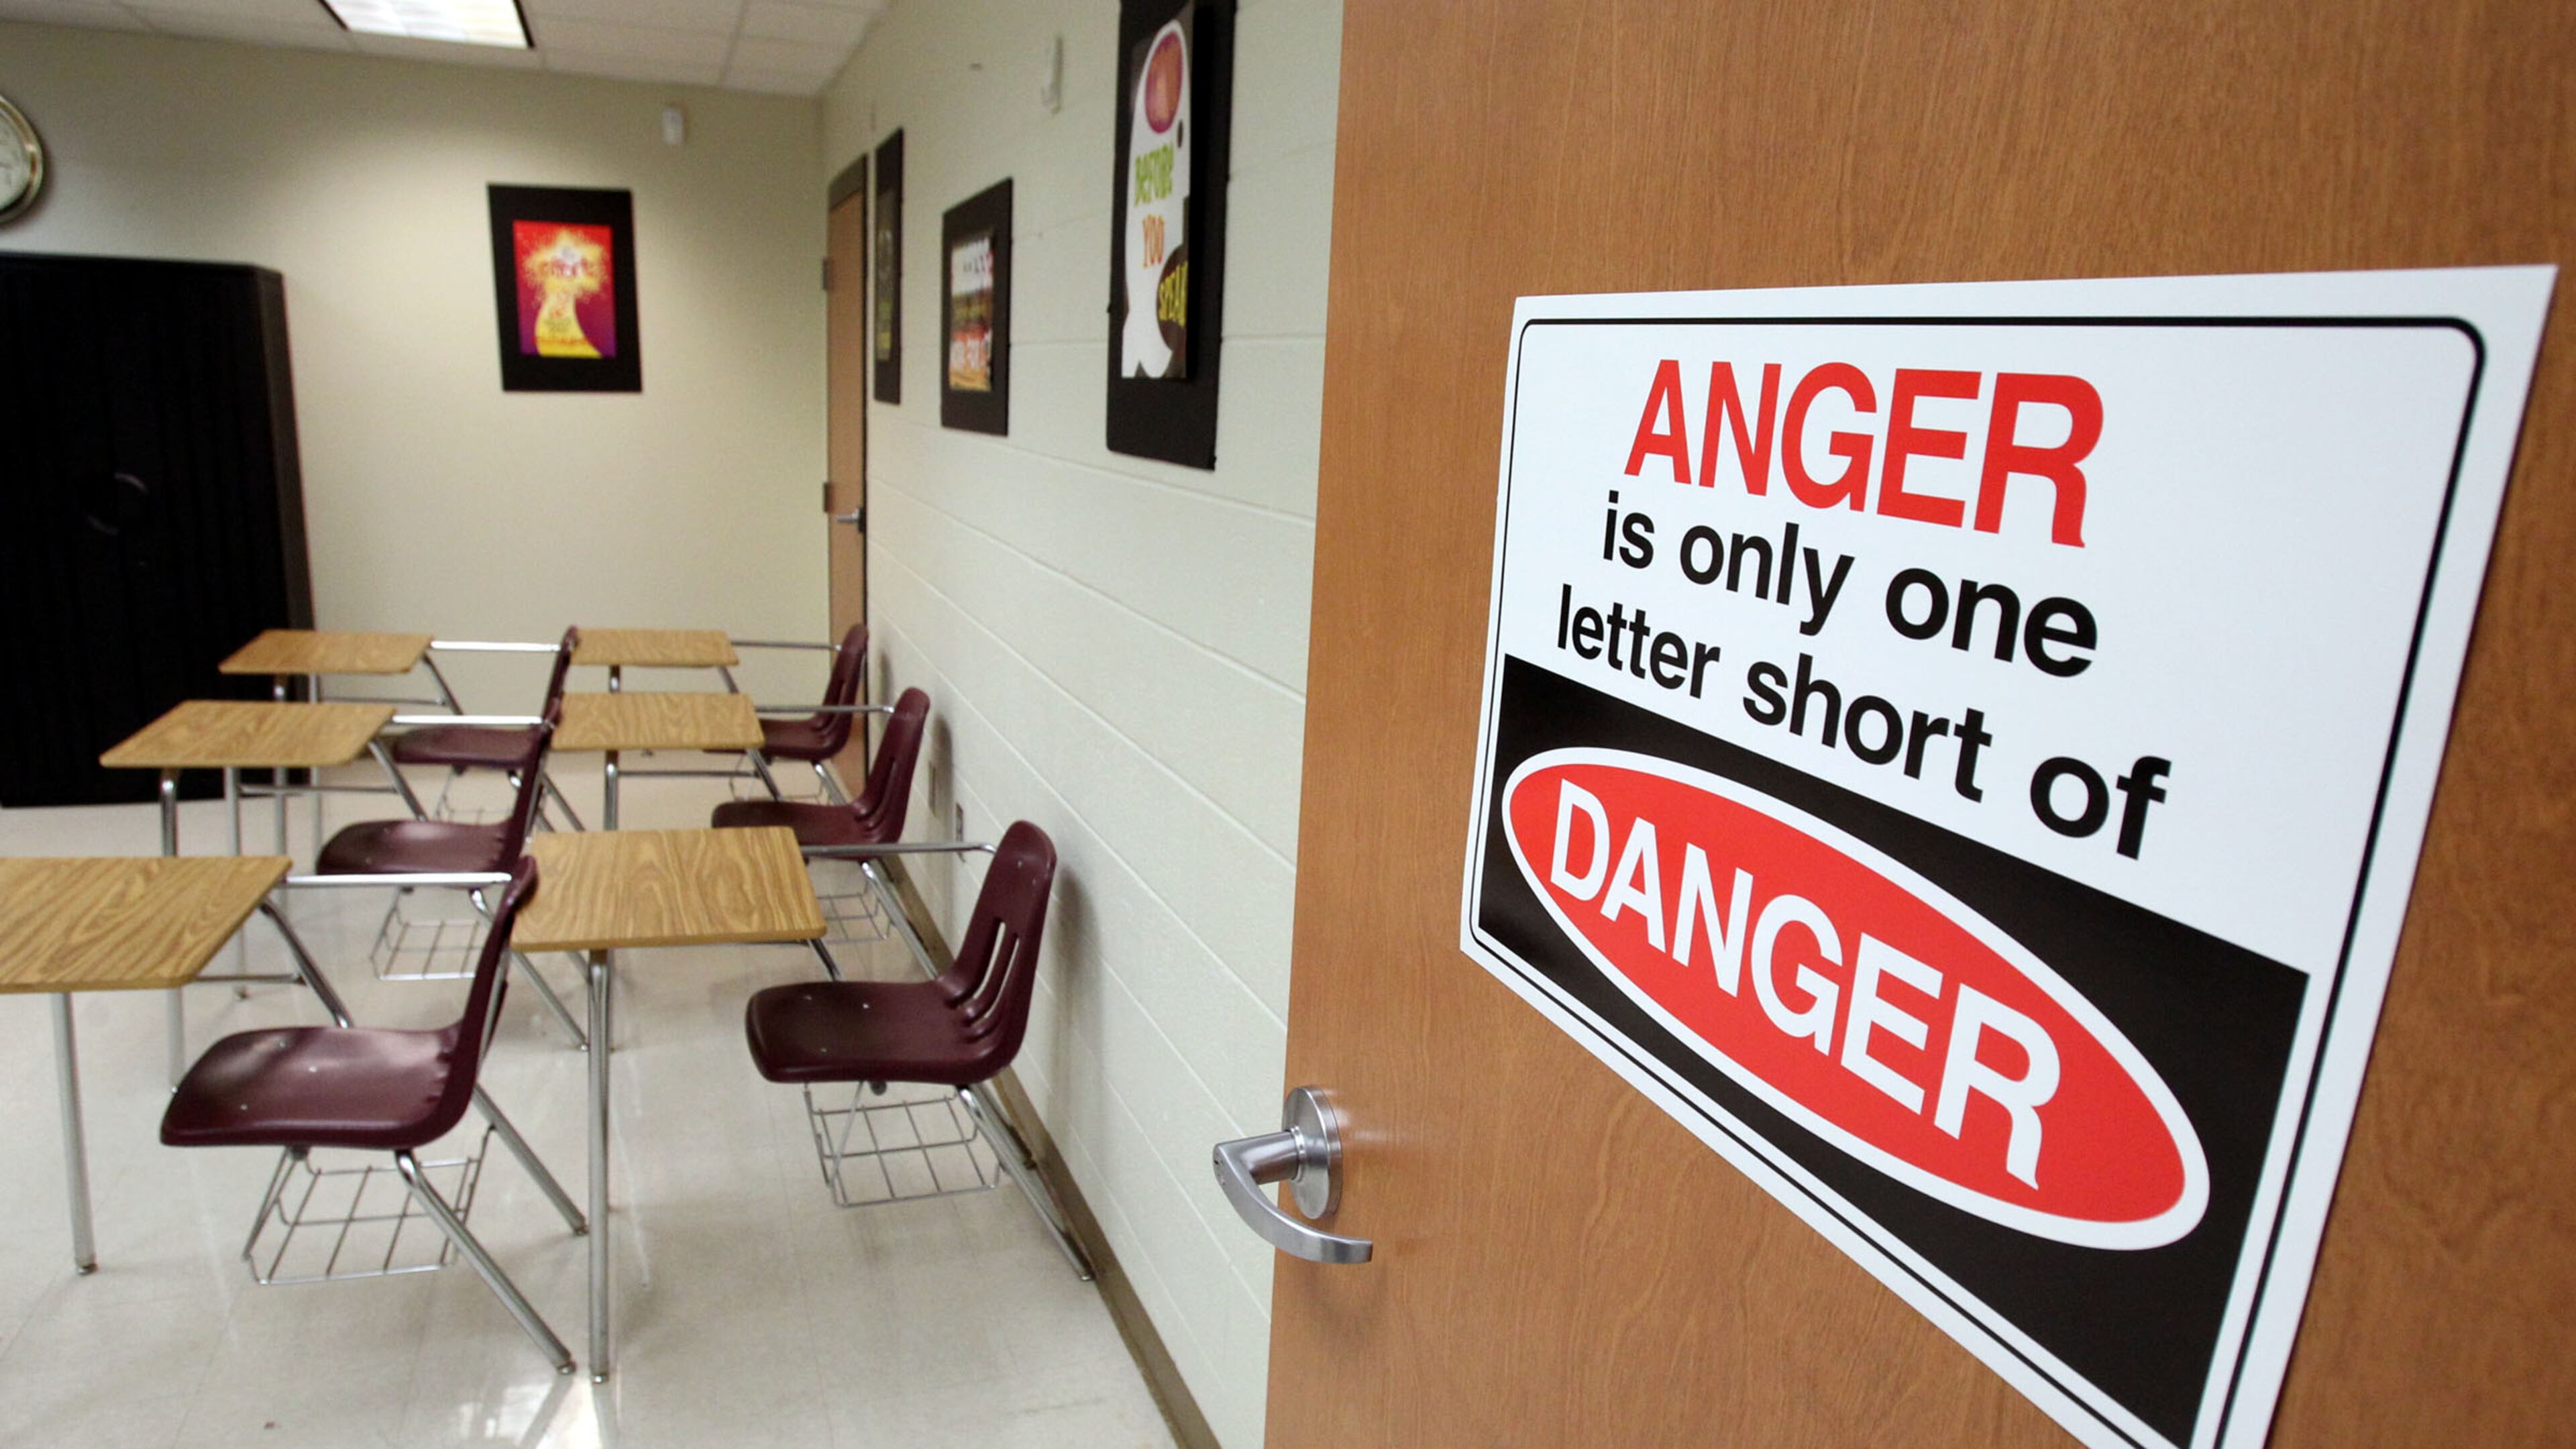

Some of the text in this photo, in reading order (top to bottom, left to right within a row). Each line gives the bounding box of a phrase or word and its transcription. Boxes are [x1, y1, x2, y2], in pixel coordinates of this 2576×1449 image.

[1142, 214, 1165, 268] YOU
[1624, 360, 2103, 547] ANGER
[1603, 489, 2097, 678] is only one
[1558, 584, 2171, 860] letter short of
[1550, 778, 2061, 1190] DANGER
